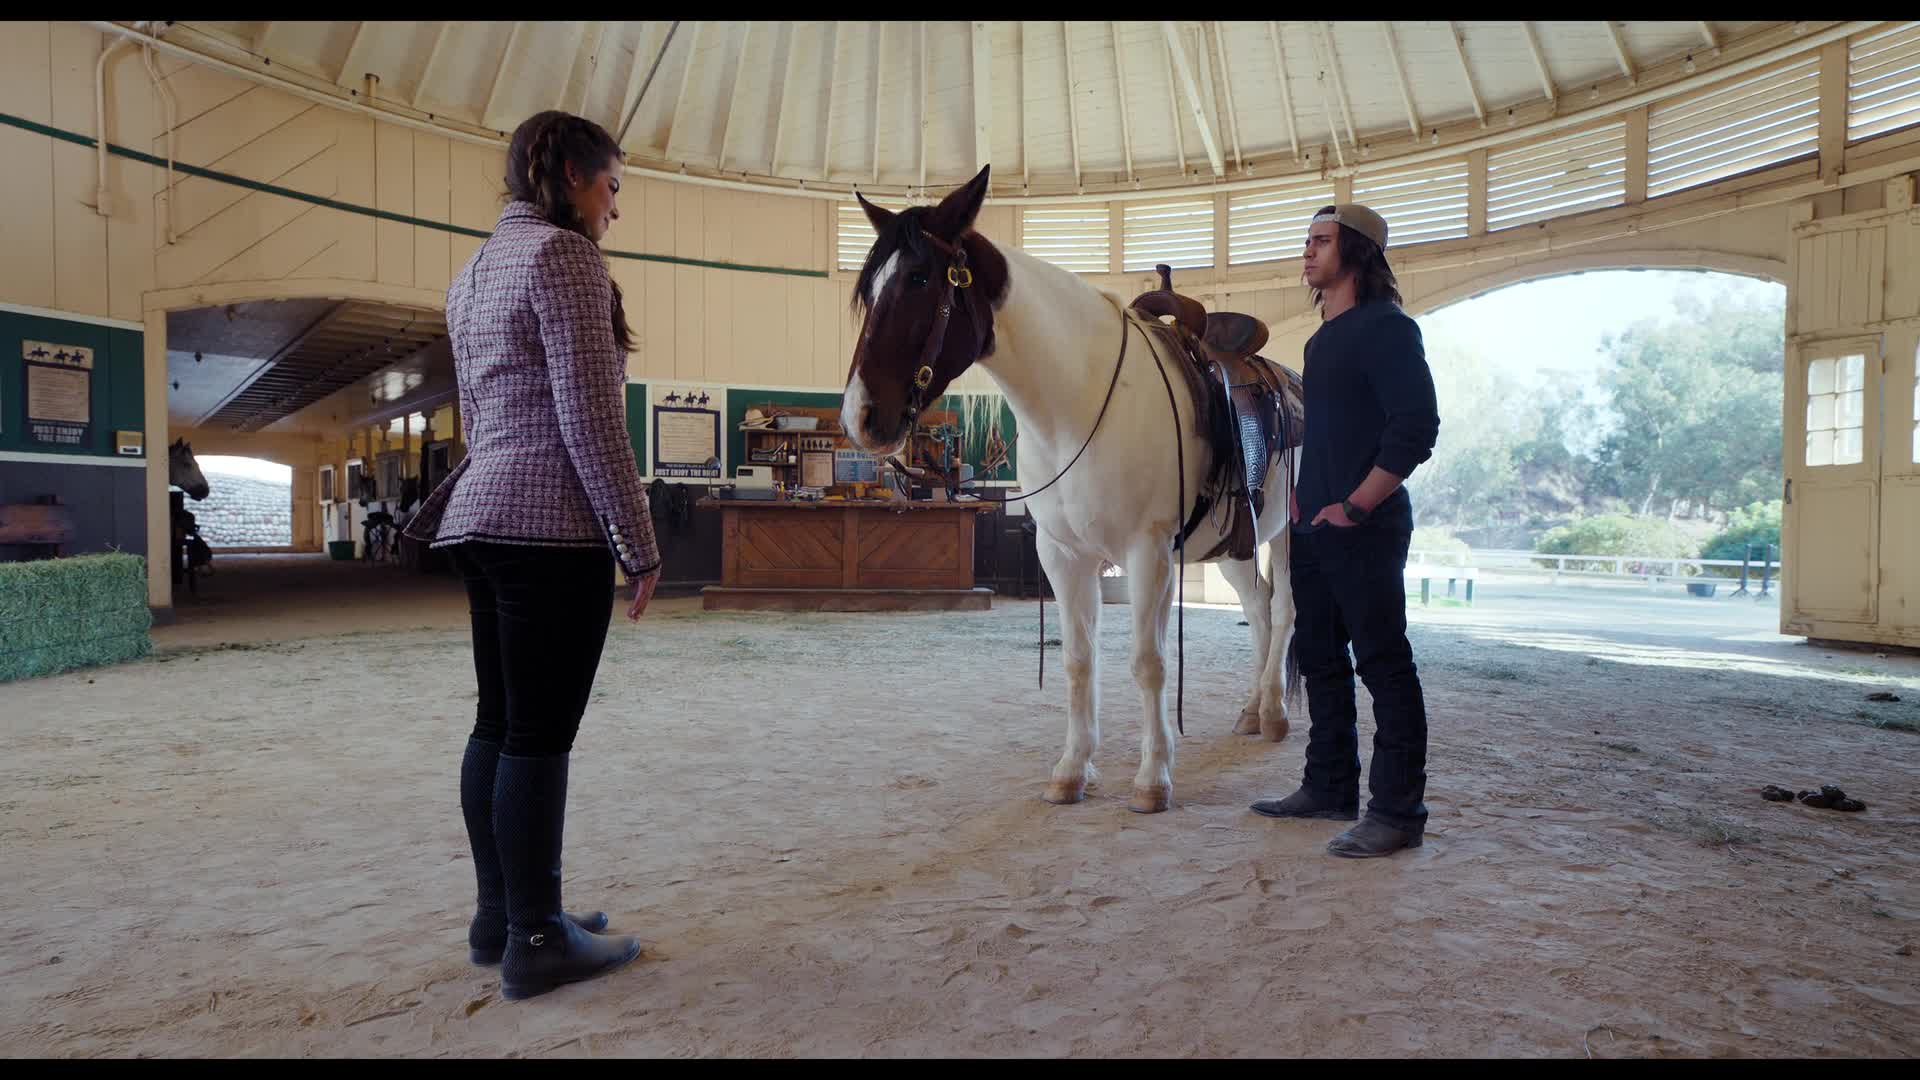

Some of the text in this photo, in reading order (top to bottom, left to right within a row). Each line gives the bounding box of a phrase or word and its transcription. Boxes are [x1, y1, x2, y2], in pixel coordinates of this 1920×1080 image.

[32, 425, 55, 434] JUST
[670, 469, 688, 477] ENJOY
[690, 469, 701, 477] THE
